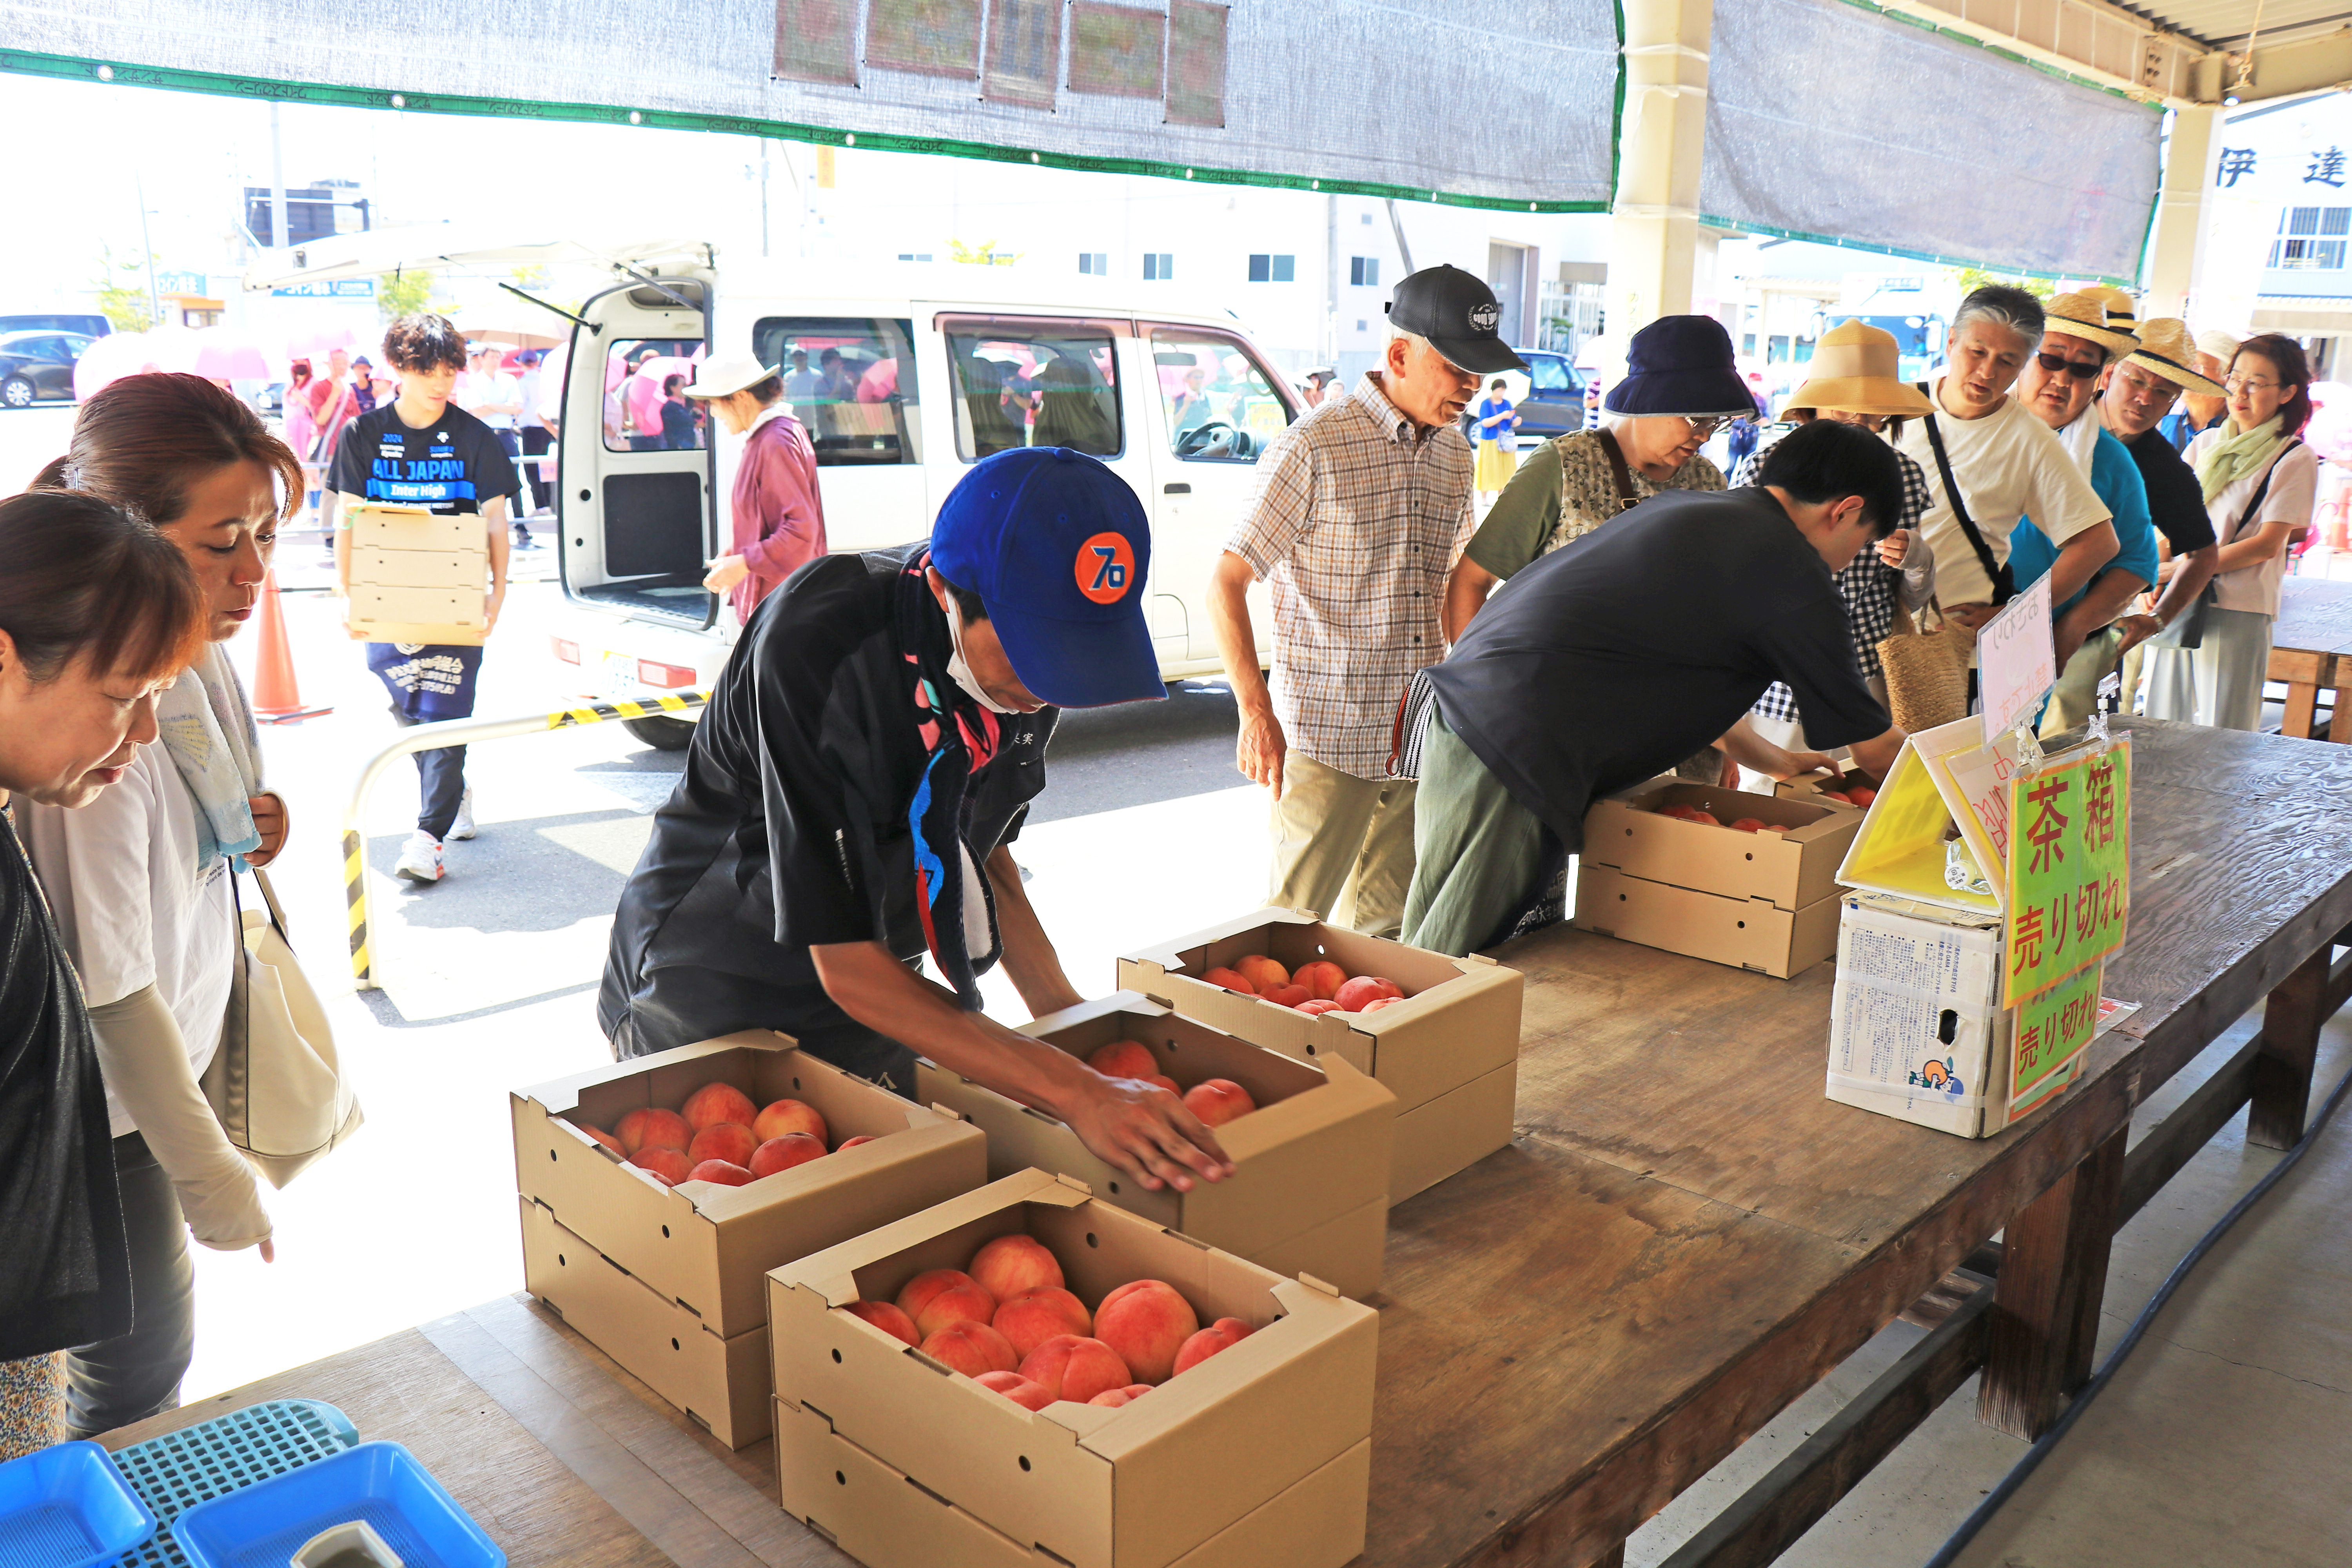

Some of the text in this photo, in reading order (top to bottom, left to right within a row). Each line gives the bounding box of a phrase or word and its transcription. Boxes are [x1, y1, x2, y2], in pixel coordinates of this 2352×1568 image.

[1626, 290, 1639, 354] カメラ作
[373, 458, 465, 481] ALL JAPAN
[390, 484, 446, 499] Inter High
[2013, 871, 2123, 977] 売り切れ
[1944, 933, 1953, 975] があるGABAと、
[1950, 935, 1962, 993] が高めの方の血圧を下げる
[2018, 990, 2094, 1076] 売り切れ
